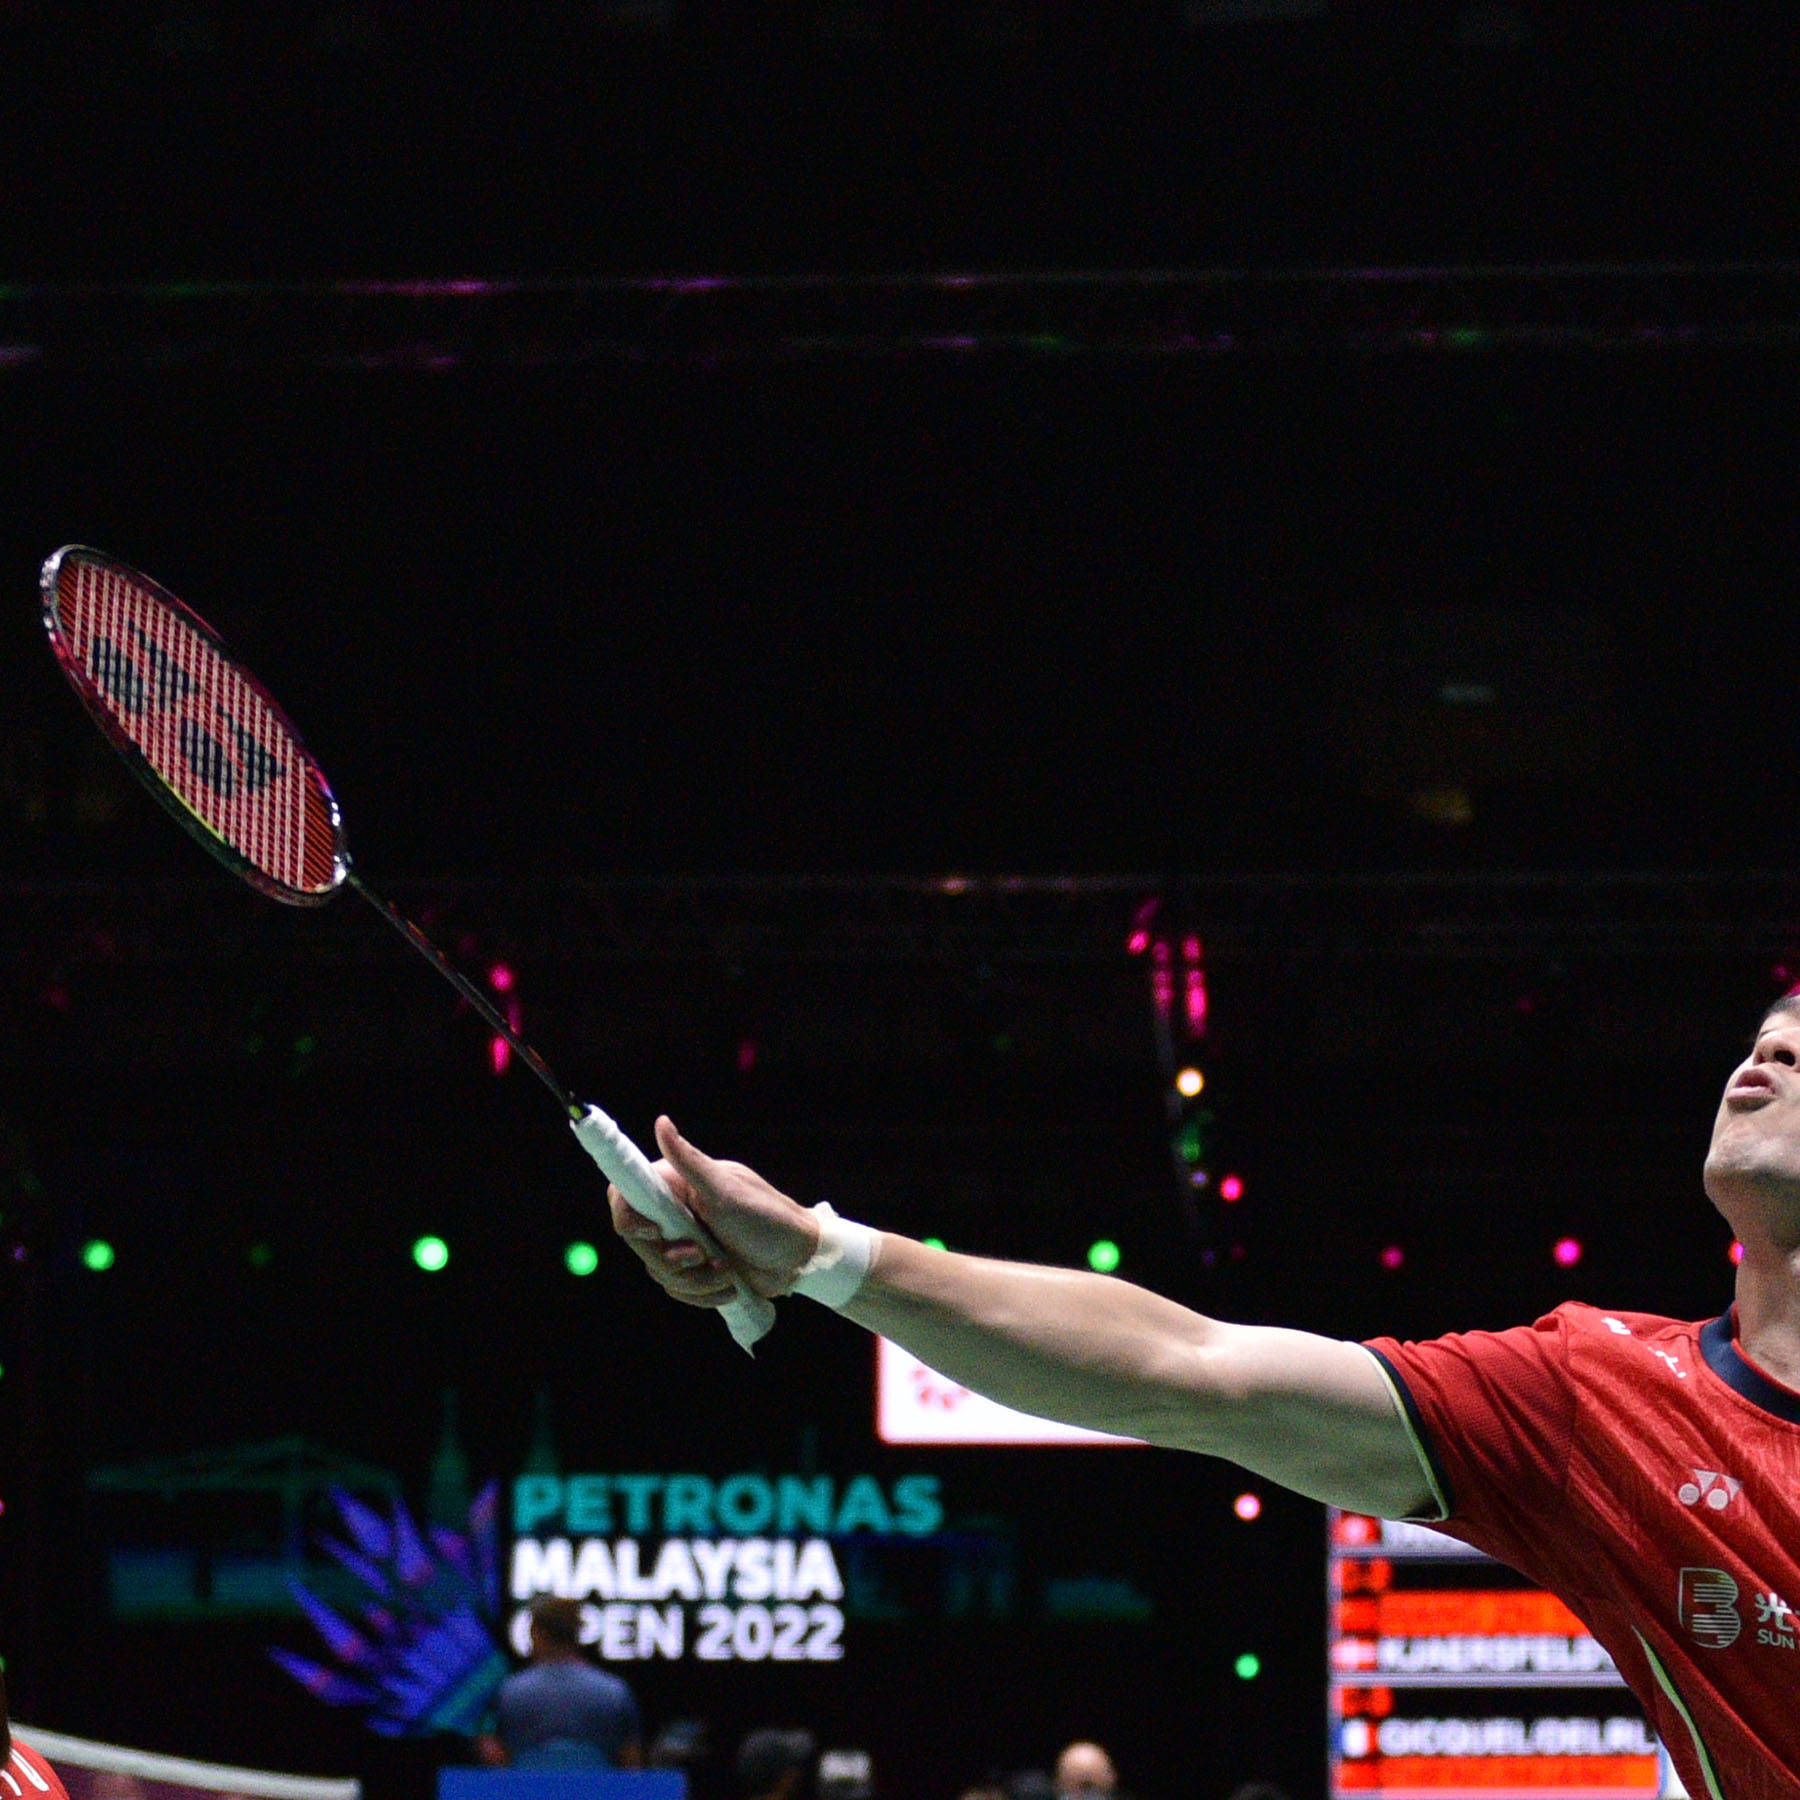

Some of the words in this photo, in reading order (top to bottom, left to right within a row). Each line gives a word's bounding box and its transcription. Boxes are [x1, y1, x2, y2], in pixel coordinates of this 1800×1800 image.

[511, 1474, 943, 1534] PETRONAS
[510, 1538, 844, 1601] MALAYSIA
[696, 1604, 844, 1661] 2022
[1758, 1629, 1796, 1650] SUN
